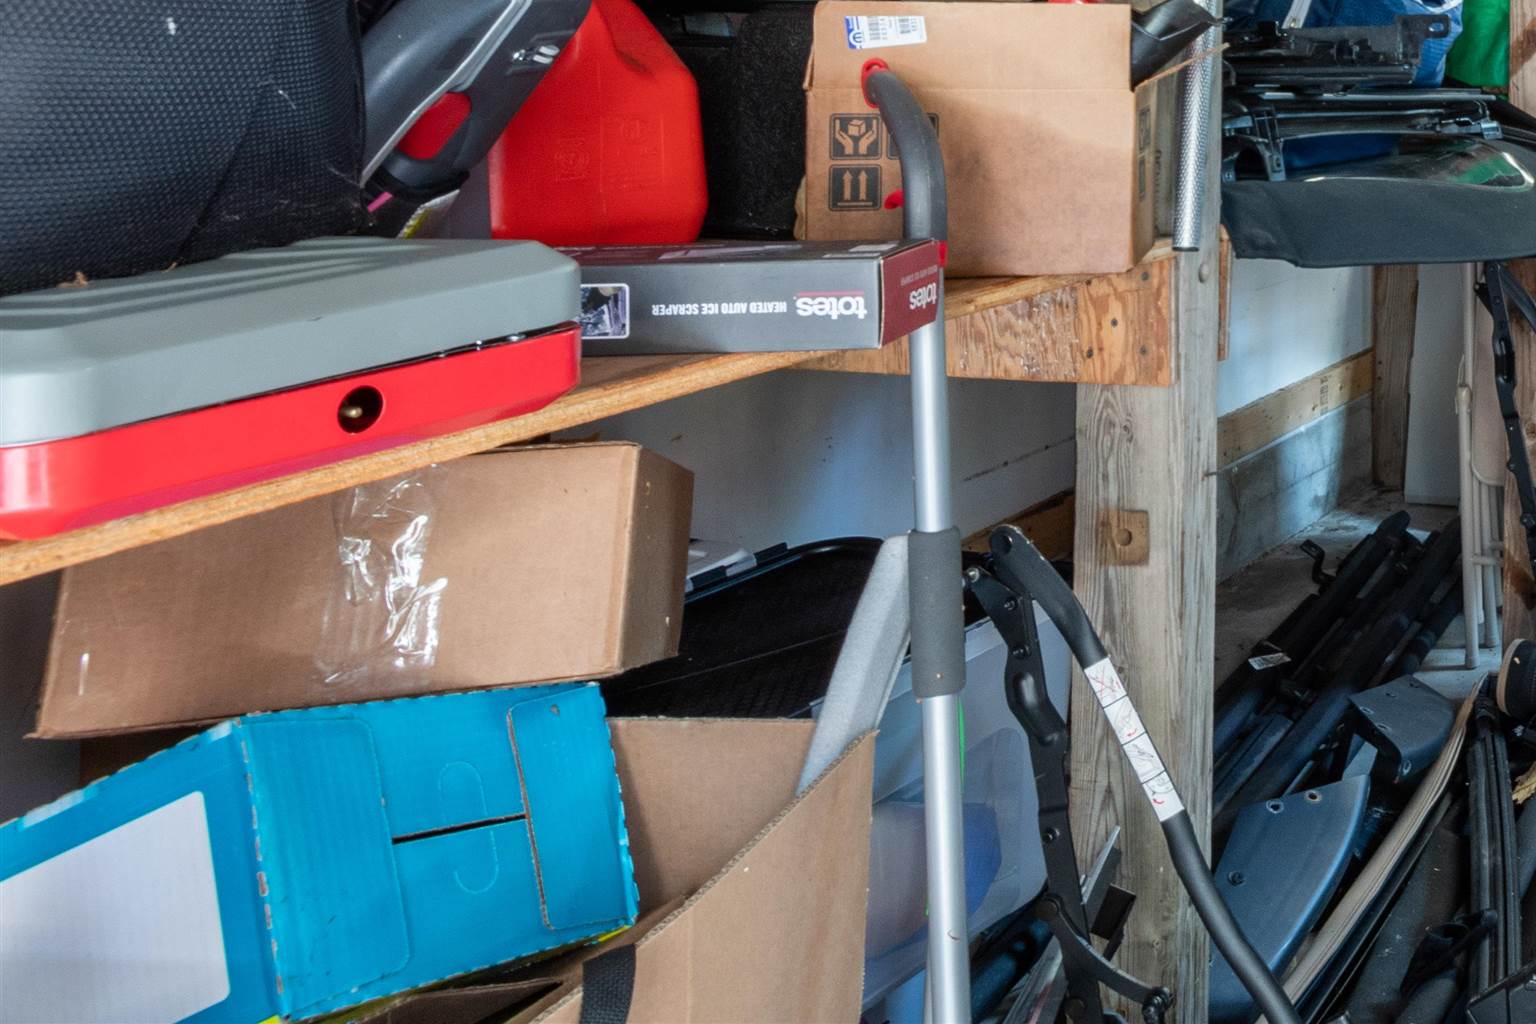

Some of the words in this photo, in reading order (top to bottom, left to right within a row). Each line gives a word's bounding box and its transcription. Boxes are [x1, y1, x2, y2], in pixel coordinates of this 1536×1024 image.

[909, 282, 937, 310] totes
[651, 303, 700, 317] SCRAPER
[700, 302, 719, 316] ICE
[721, 301, 748, 315] AUTO
[749, 300, 788, 314] HEATED
